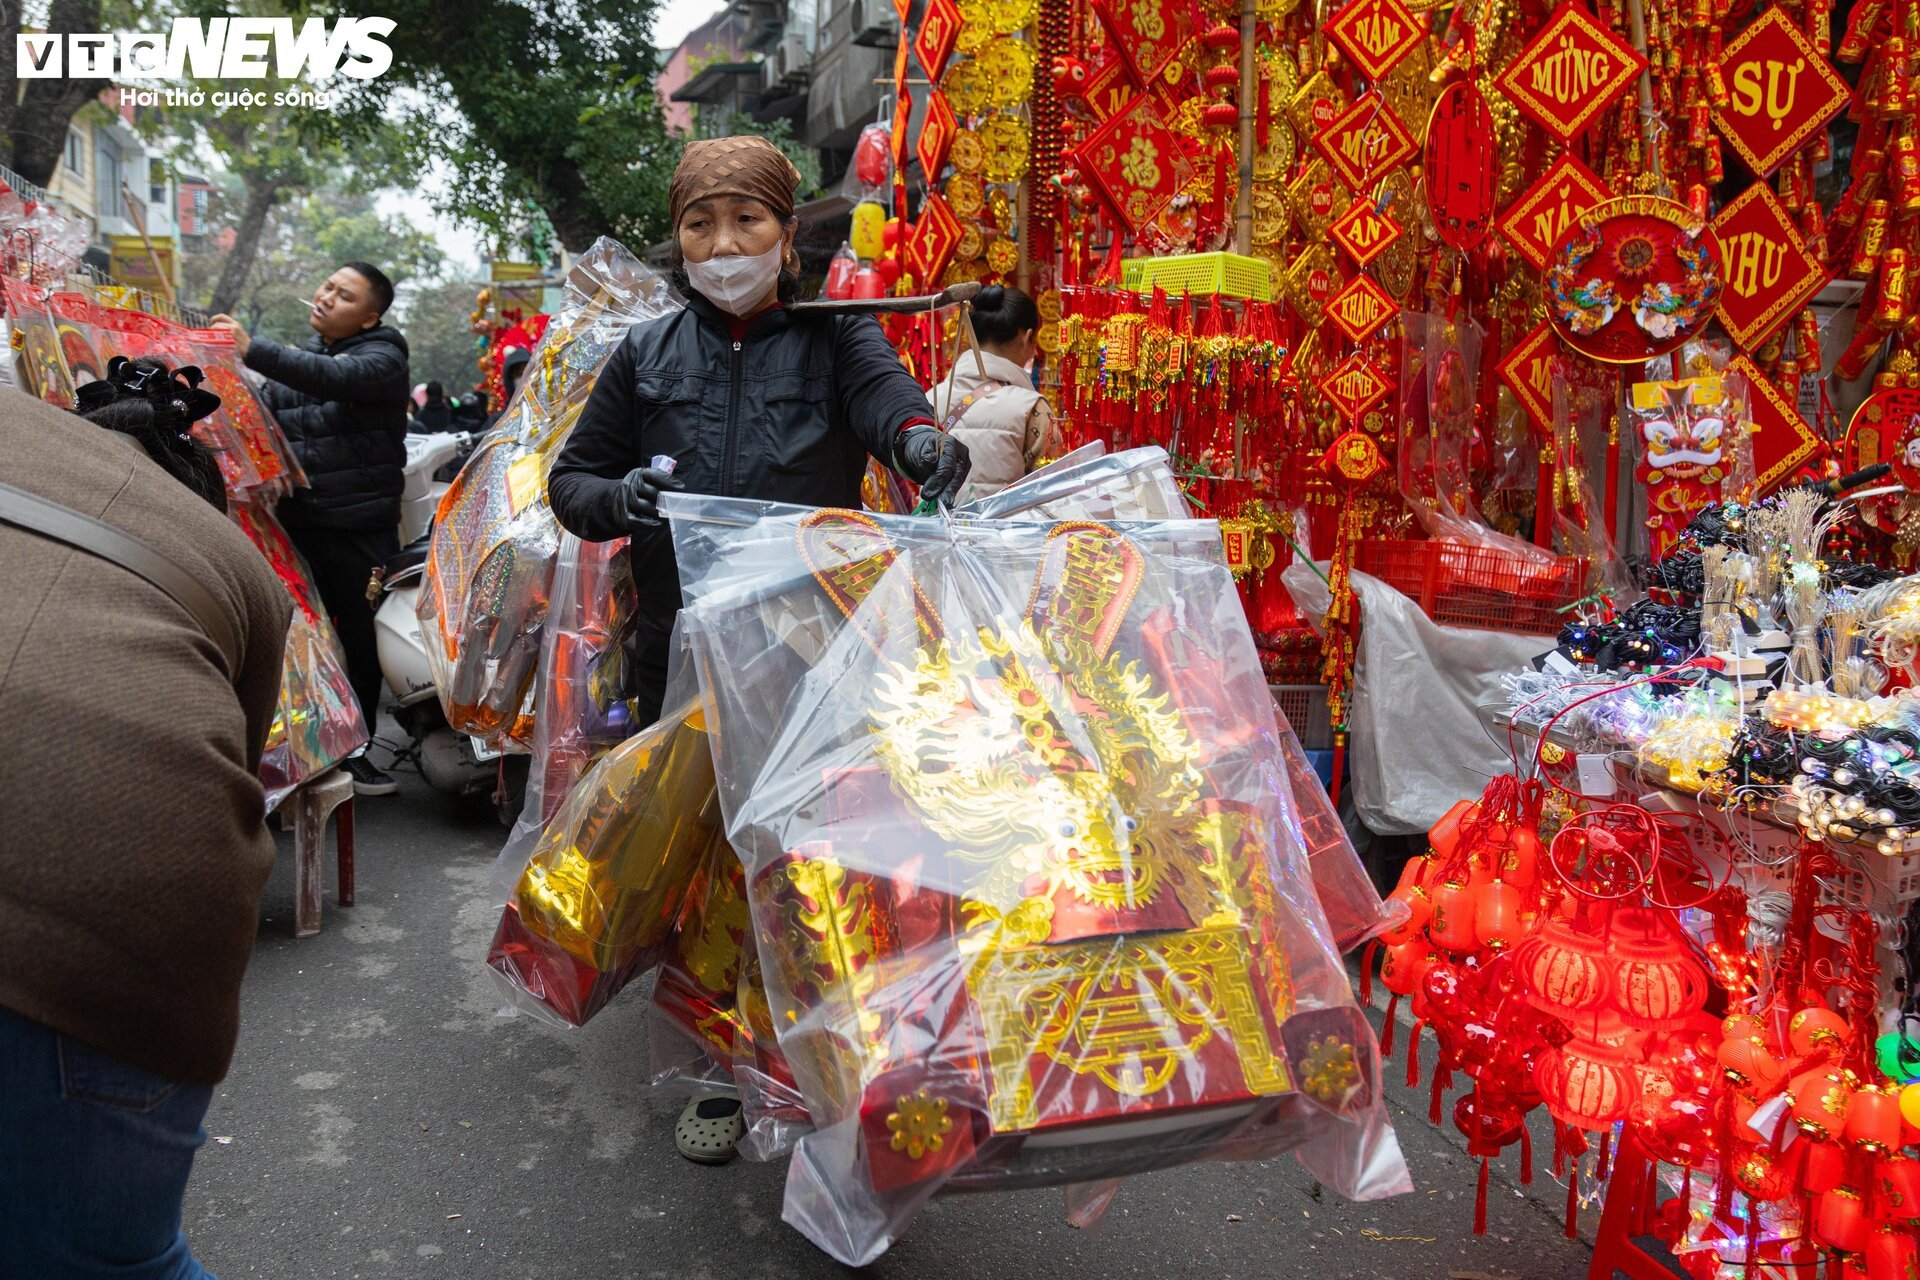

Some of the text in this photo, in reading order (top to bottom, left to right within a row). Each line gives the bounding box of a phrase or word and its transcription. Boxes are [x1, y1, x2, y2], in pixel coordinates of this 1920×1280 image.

[1354, 1, 1401, 58] NĂM
[1530, 36, 1611, 105] MỪNG
[1731, 57, 1806, 131] SỰ
[1314, 104, 1334, 121] CHÚC
[1119, 135, 1161, 189] 福
[1339, 118, 1391, 169] MỚI
[1346, 215, 1383, 249] AN
[1533, 184, 1584, 248] NĂ
[1610, 198, 1648, 217] Mừng
[1341, 290, 1379, 328] KHANG
